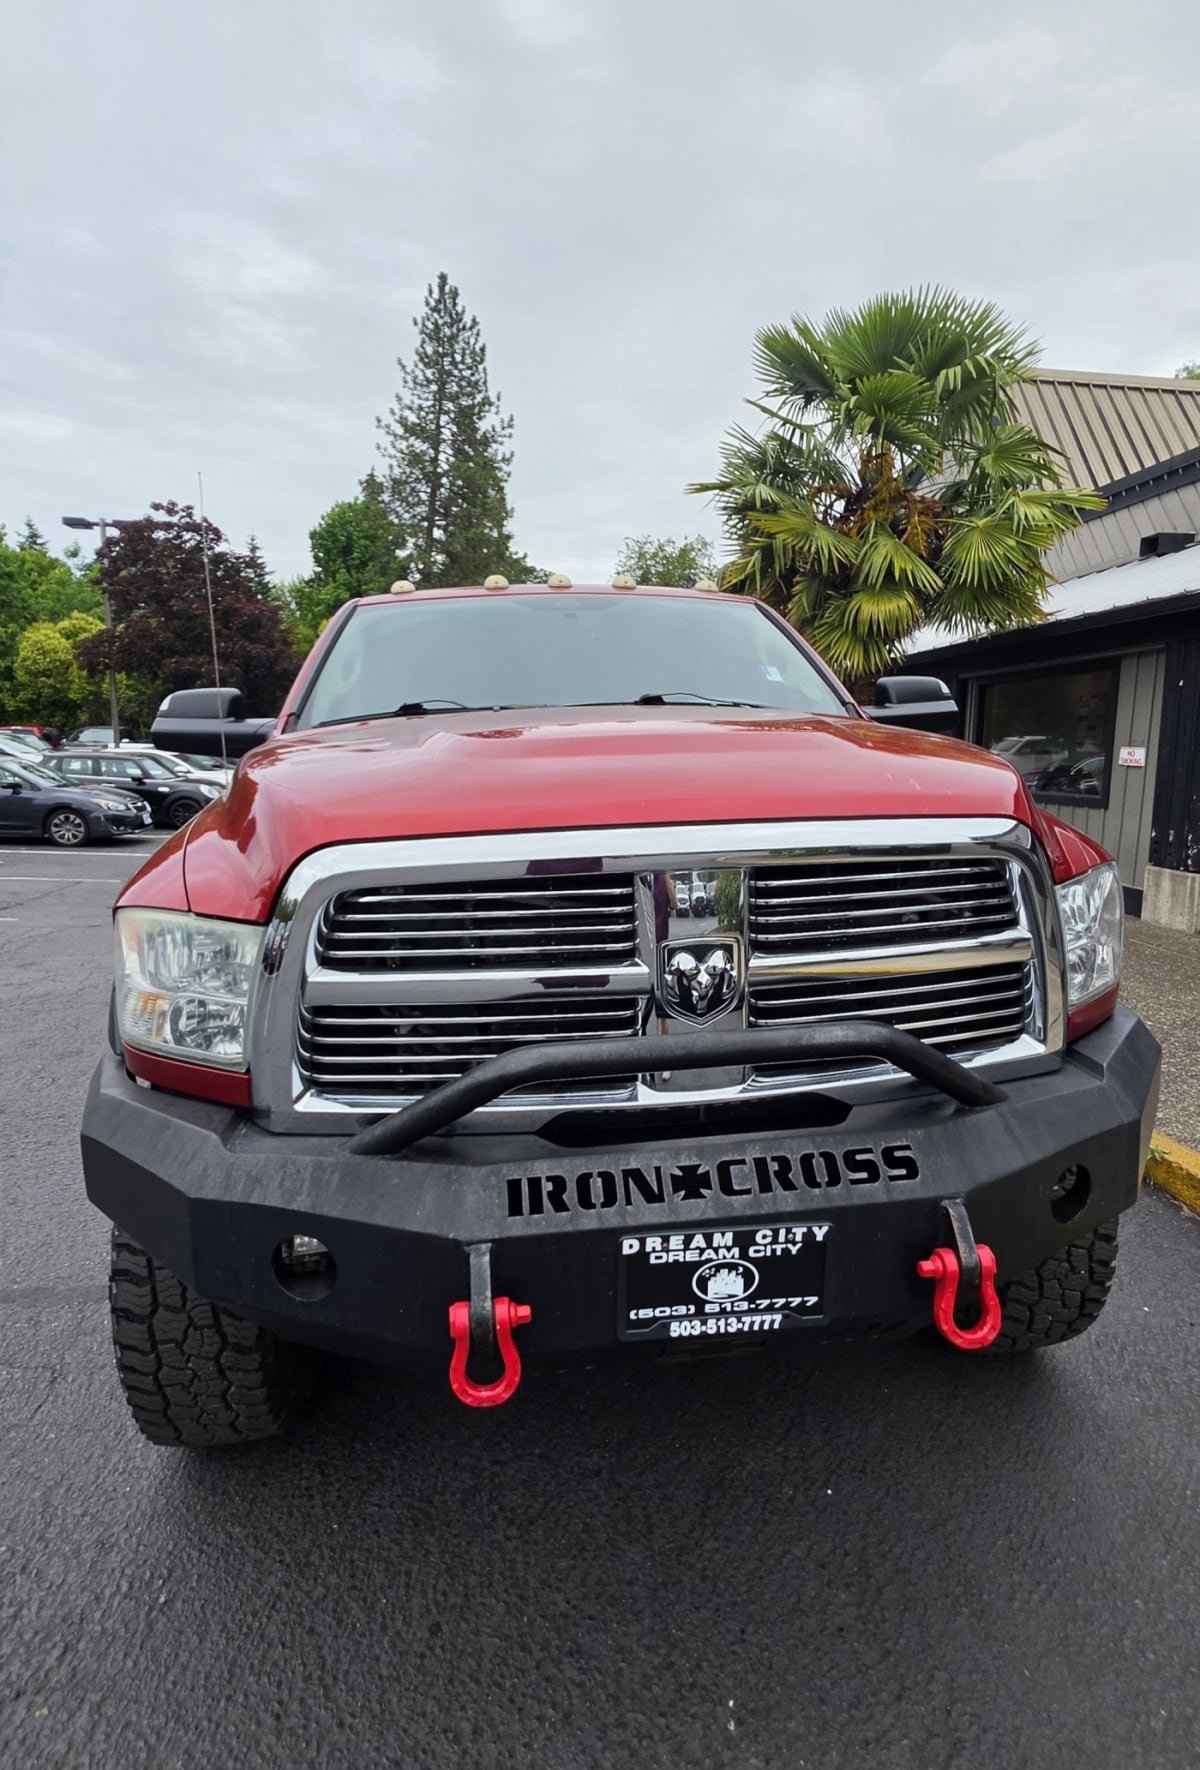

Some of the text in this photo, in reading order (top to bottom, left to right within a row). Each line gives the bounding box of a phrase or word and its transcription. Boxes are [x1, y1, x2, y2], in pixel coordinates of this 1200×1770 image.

[506, 1143, 920, 1217] IRON CROSS
[622, 1226, 830, 1255] DREAM CITY
[649, 1243, 803, 1264] DREAM CITY
[629, 1296, 819, 1320] (503) 513-7777
[669, 1314, 783, 1337] 503-513-7777
